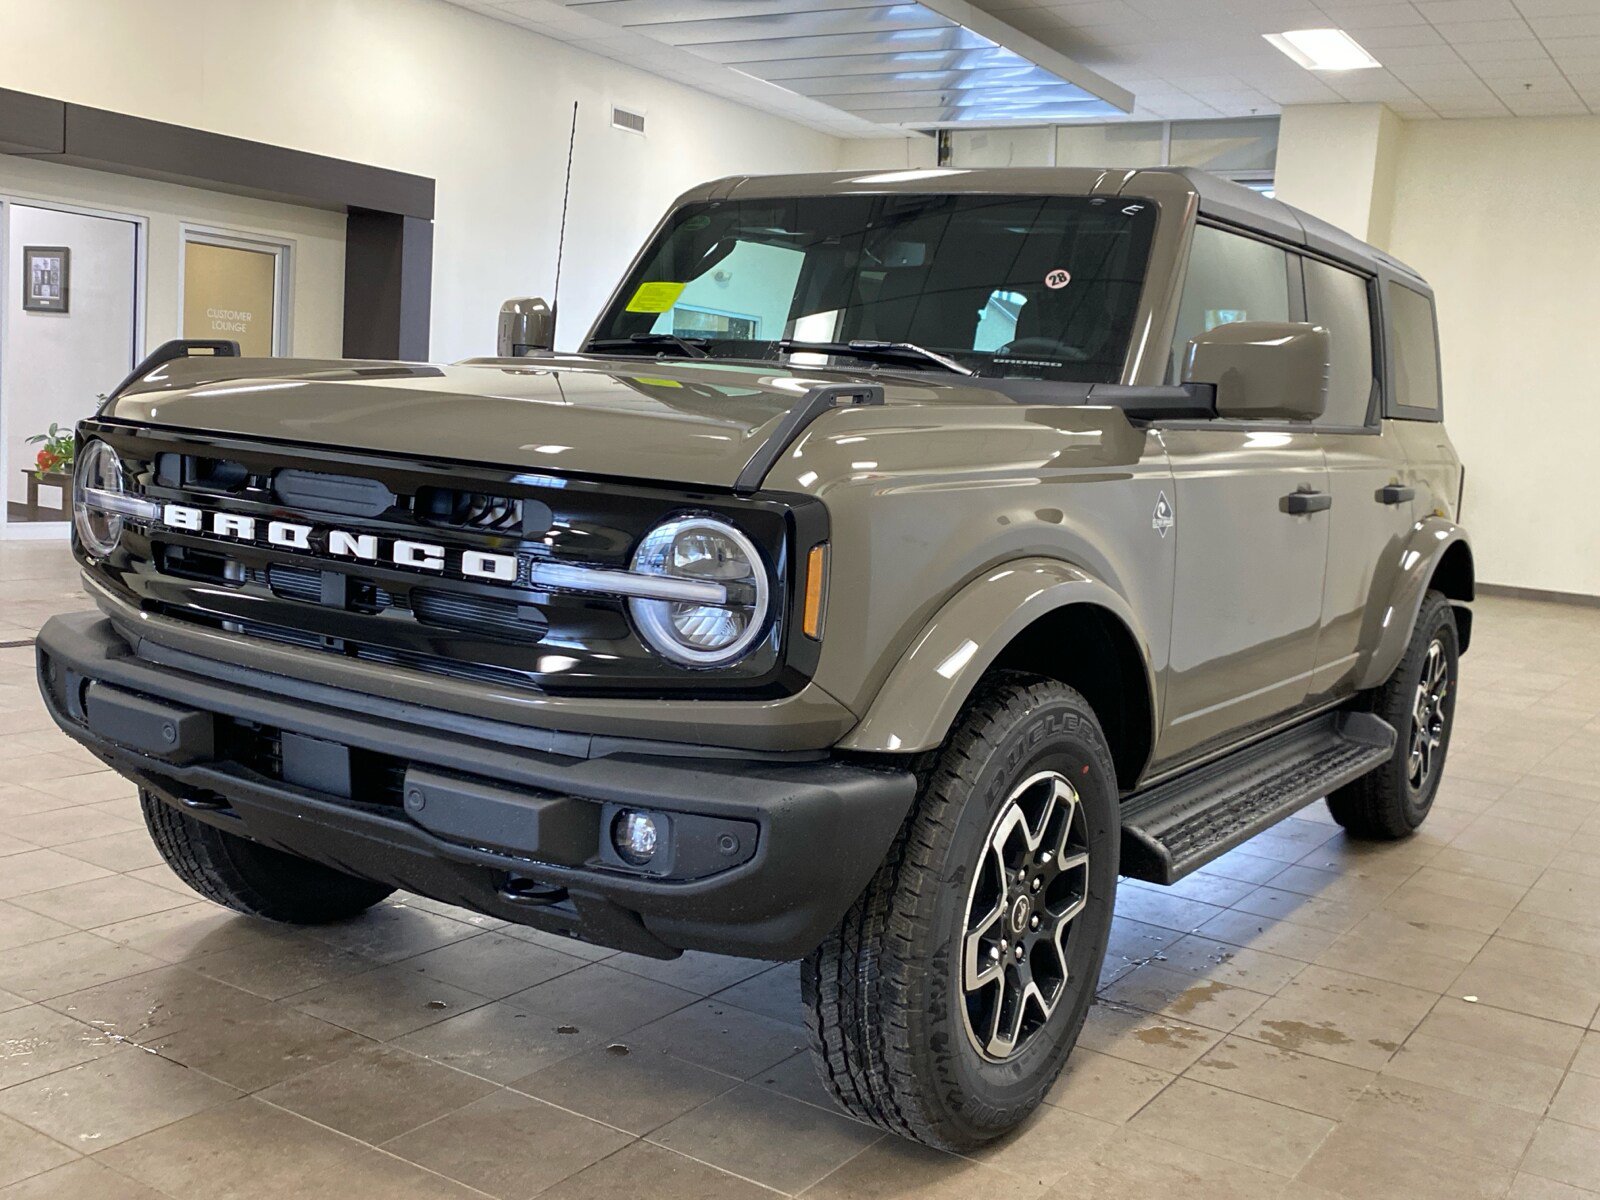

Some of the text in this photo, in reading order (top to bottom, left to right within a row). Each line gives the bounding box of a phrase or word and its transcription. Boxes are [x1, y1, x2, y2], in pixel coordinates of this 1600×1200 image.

[1048, 271, 1068, 287] 28
[206, 308, 252, 322] CUSTOMER
[211, 320, 247, 333] LOUNGE
[163, 503, 517, 582] BRONCO
[984, 711, 1096, 810] DUELER
